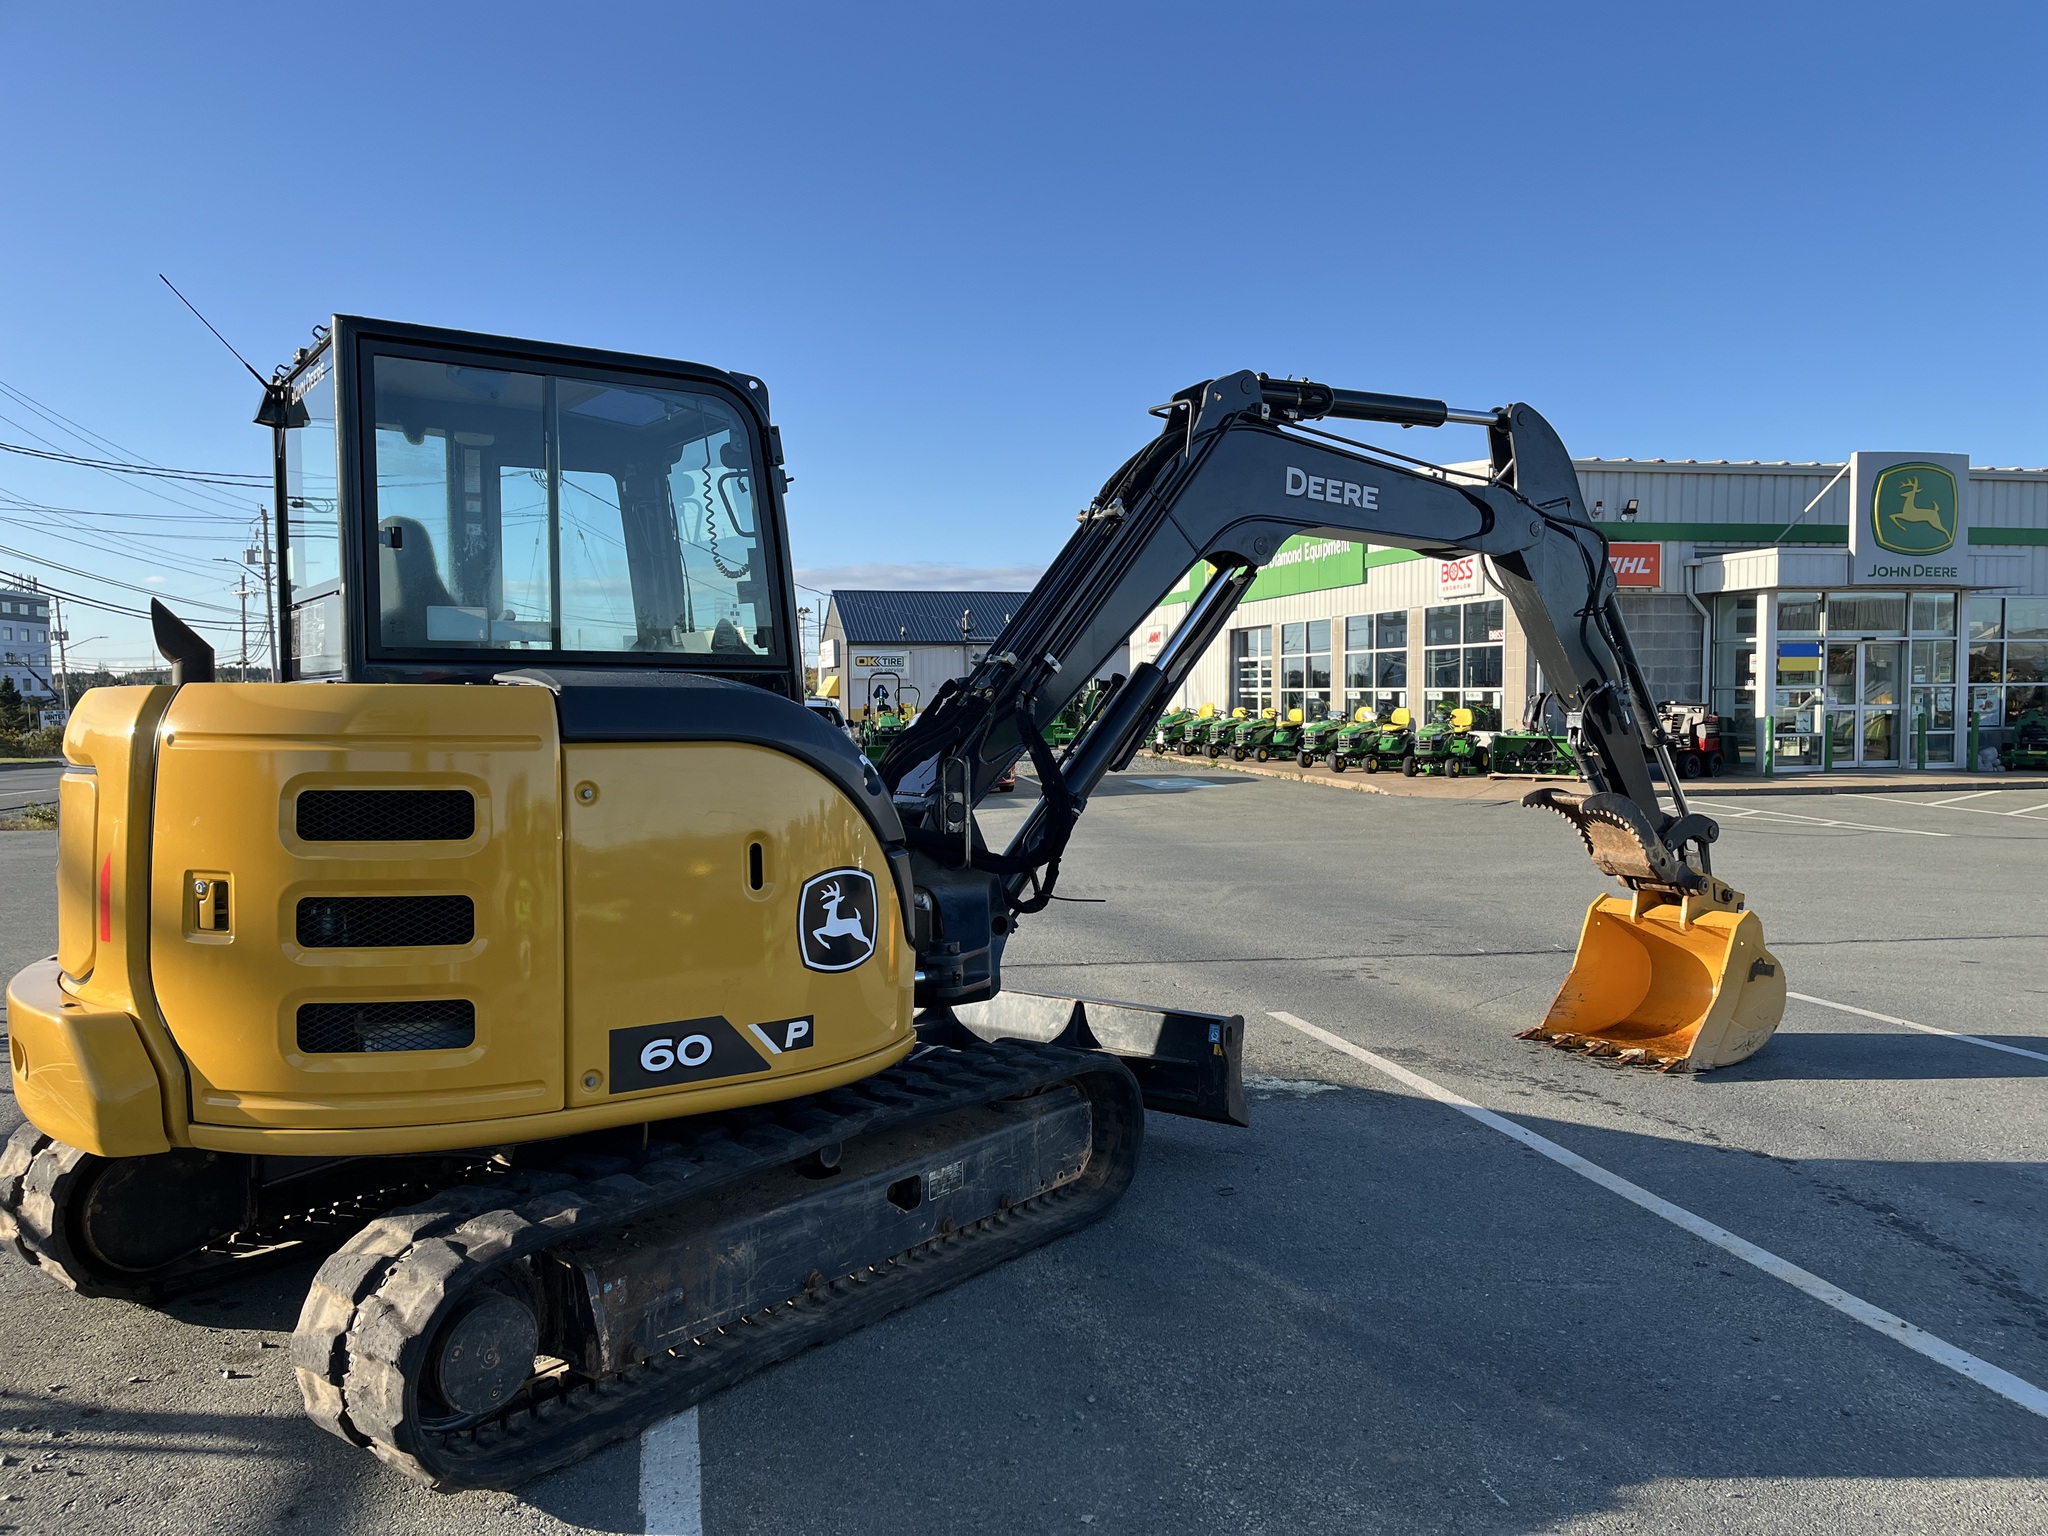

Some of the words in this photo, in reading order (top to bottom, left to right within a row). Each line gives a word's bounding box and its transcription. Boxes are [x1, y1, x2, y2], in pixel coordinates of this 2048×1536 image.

[1285, 466, 1379, 510] DEERE
[1304, 539, 1350, 563] Equipment
[1441, 559, 1473, 583] BOSS
[1608, 557, 1651, 573] TIHL
[1867, 564, 1911, 577] JOHN
[1913, 564, 1958, 577] DEERE
[856, 656, 877, 666] OK
[640, 1034, 713, 1072] 60
[784, 1020, 809, 1048] P
